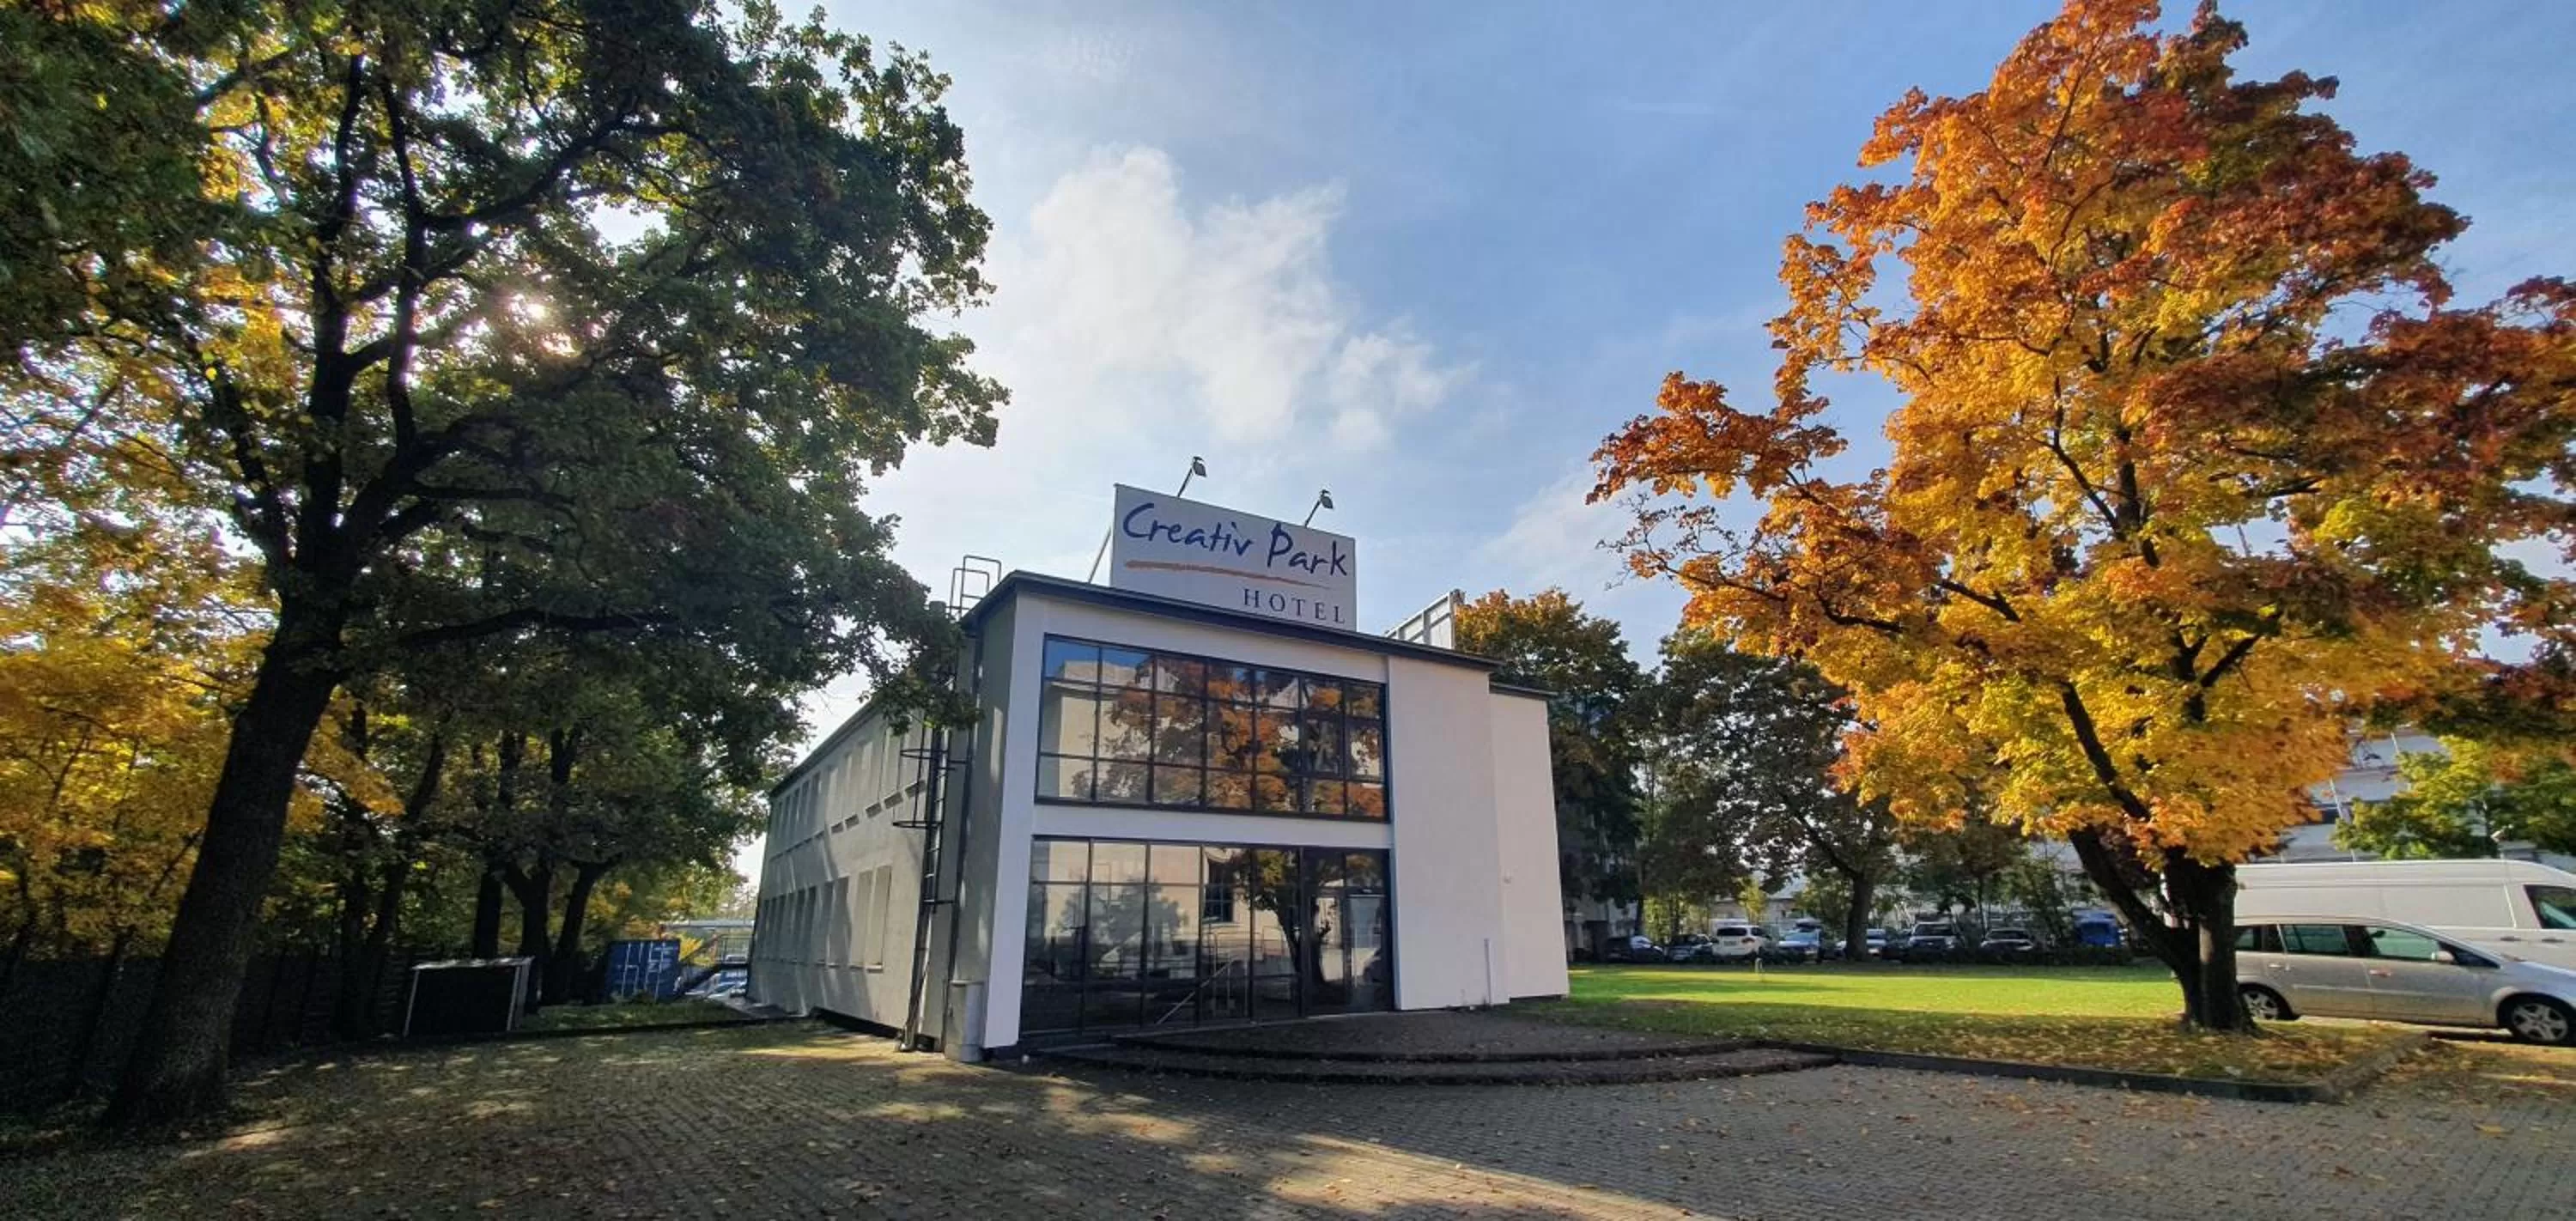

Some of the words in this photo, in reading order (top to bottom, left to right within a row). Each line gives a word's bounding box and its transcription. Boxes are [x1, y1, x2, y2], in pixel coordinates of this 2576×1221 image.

[1122, 502, 1255, 556] Creativ
[1267, 522, 1347, 576] Park
[1243, 588, 1346, 624] HOTEL
